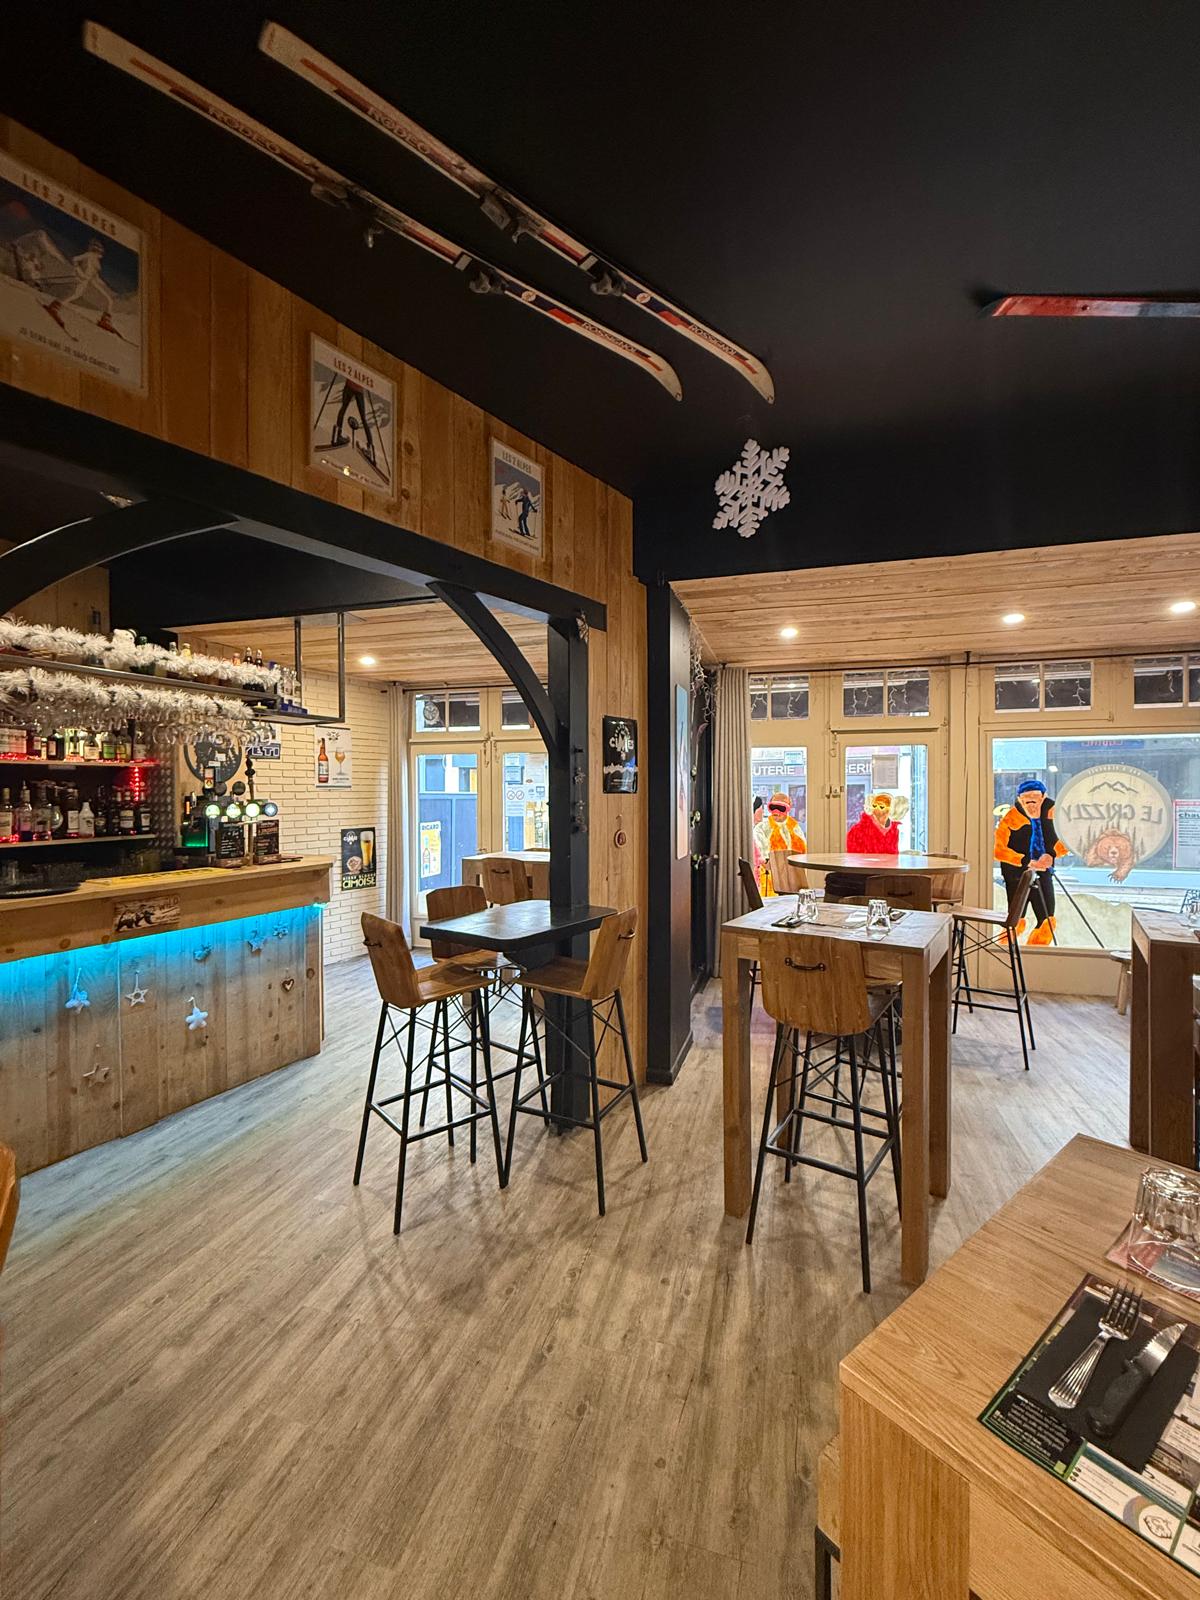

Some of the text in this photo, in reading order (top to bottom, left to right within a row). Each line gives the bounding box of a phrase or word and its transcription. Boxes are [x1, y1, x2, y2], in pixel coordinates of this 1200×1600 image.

[23, 172, 117, 236] LES 2 ALPES
[334, 357, 374, 388] LES 2 ALPES
